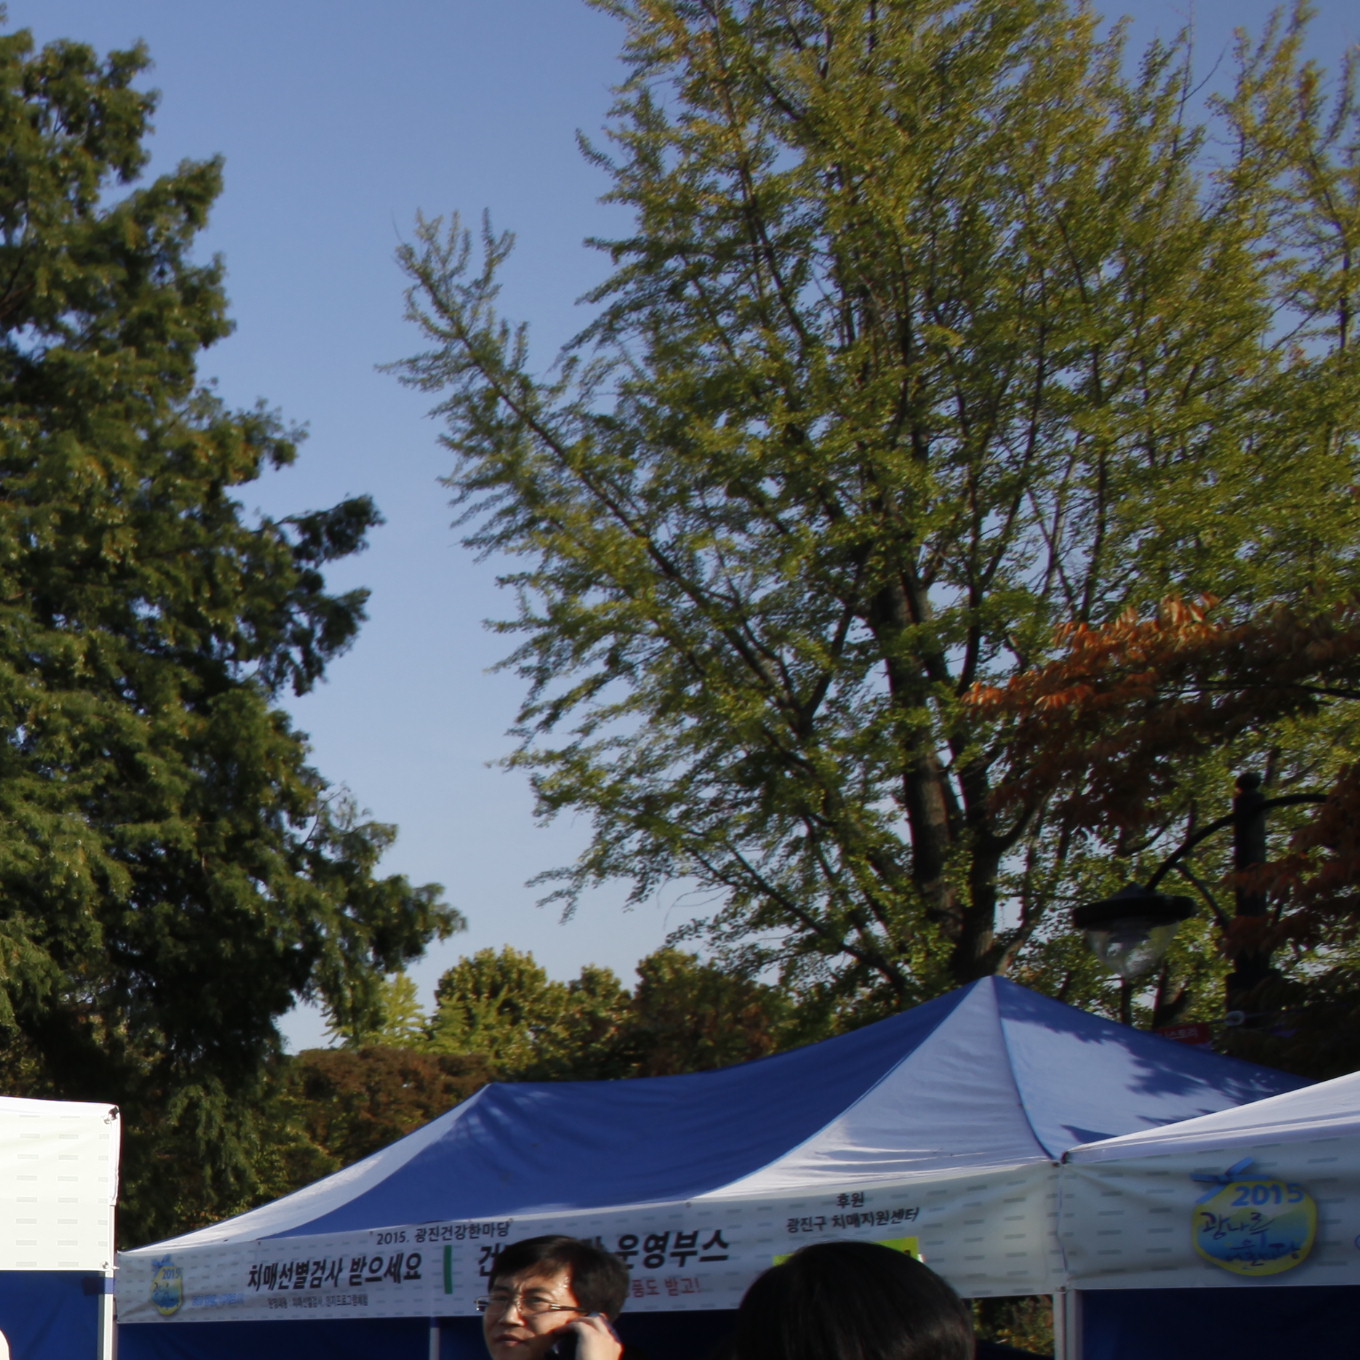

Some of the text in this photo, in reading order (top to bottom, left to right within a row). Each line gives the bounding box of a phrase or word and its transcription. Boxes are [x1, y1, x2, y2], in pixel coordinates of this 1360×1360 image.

[836, 1192, 865, 1208] 후원
[1231, 1184, 1305, 1206] 2015
[786, 1206, 920, 1233] 광진구 치매지원센터
[376, 1220, 511, 1246] 2015. 광진건강한마당
[618, 1230, 729, 1270] 운영부스
[247, 1252, 423, 1292] 치매선별검사 받으세요
